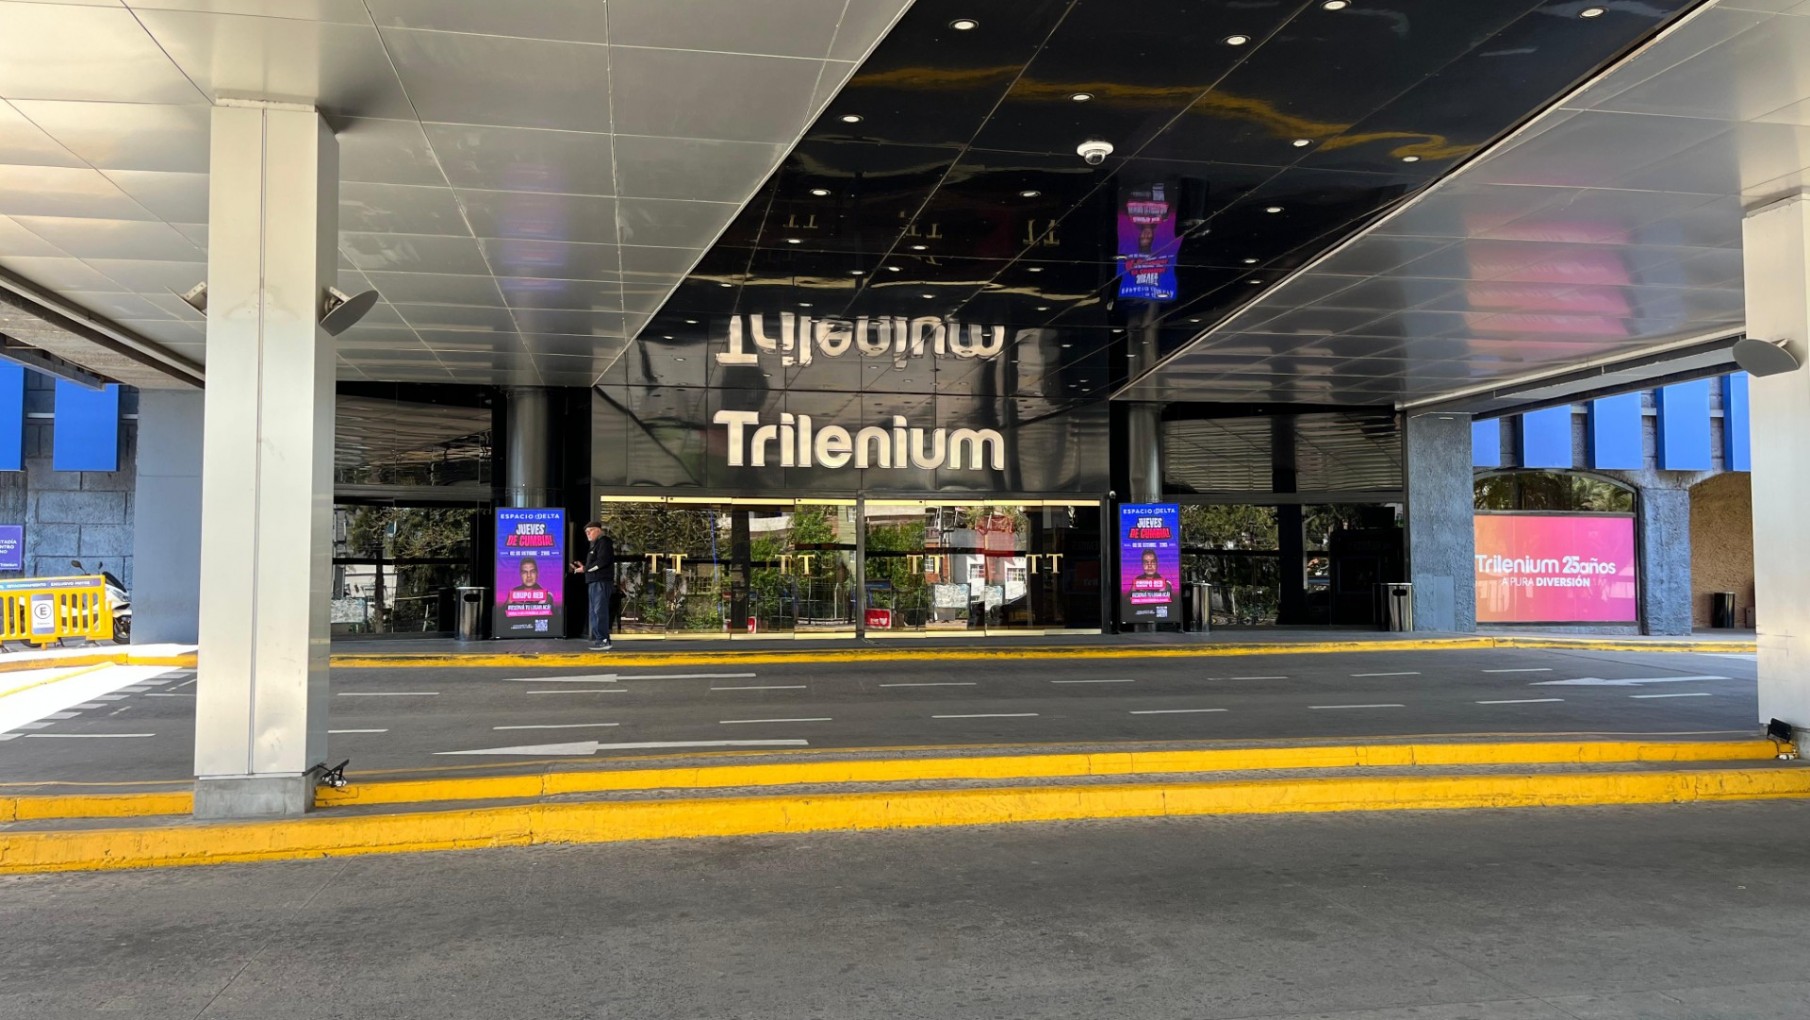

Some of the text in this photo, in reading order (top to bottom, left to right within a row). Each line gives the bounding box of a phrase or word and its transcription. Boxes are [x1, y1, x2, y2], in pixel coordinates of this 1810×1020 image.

[713, 410, 1004, 471] Trilenium
[1137, 517, 1162, 528] JUEVES
[516, 523, 545, 535] JUEVES
[1129, 528, 1139, 538] DE
[506, 534, 518, 546] DE
[1475, 555, 1559, 574] Trilenium
[1510, 578, 1534, 586] PURA
[1536, 575, 1590, 587] DIVERSIÓN
[512, 591, 532, 599] GRUPO
[40, 606, 47, 616] E
